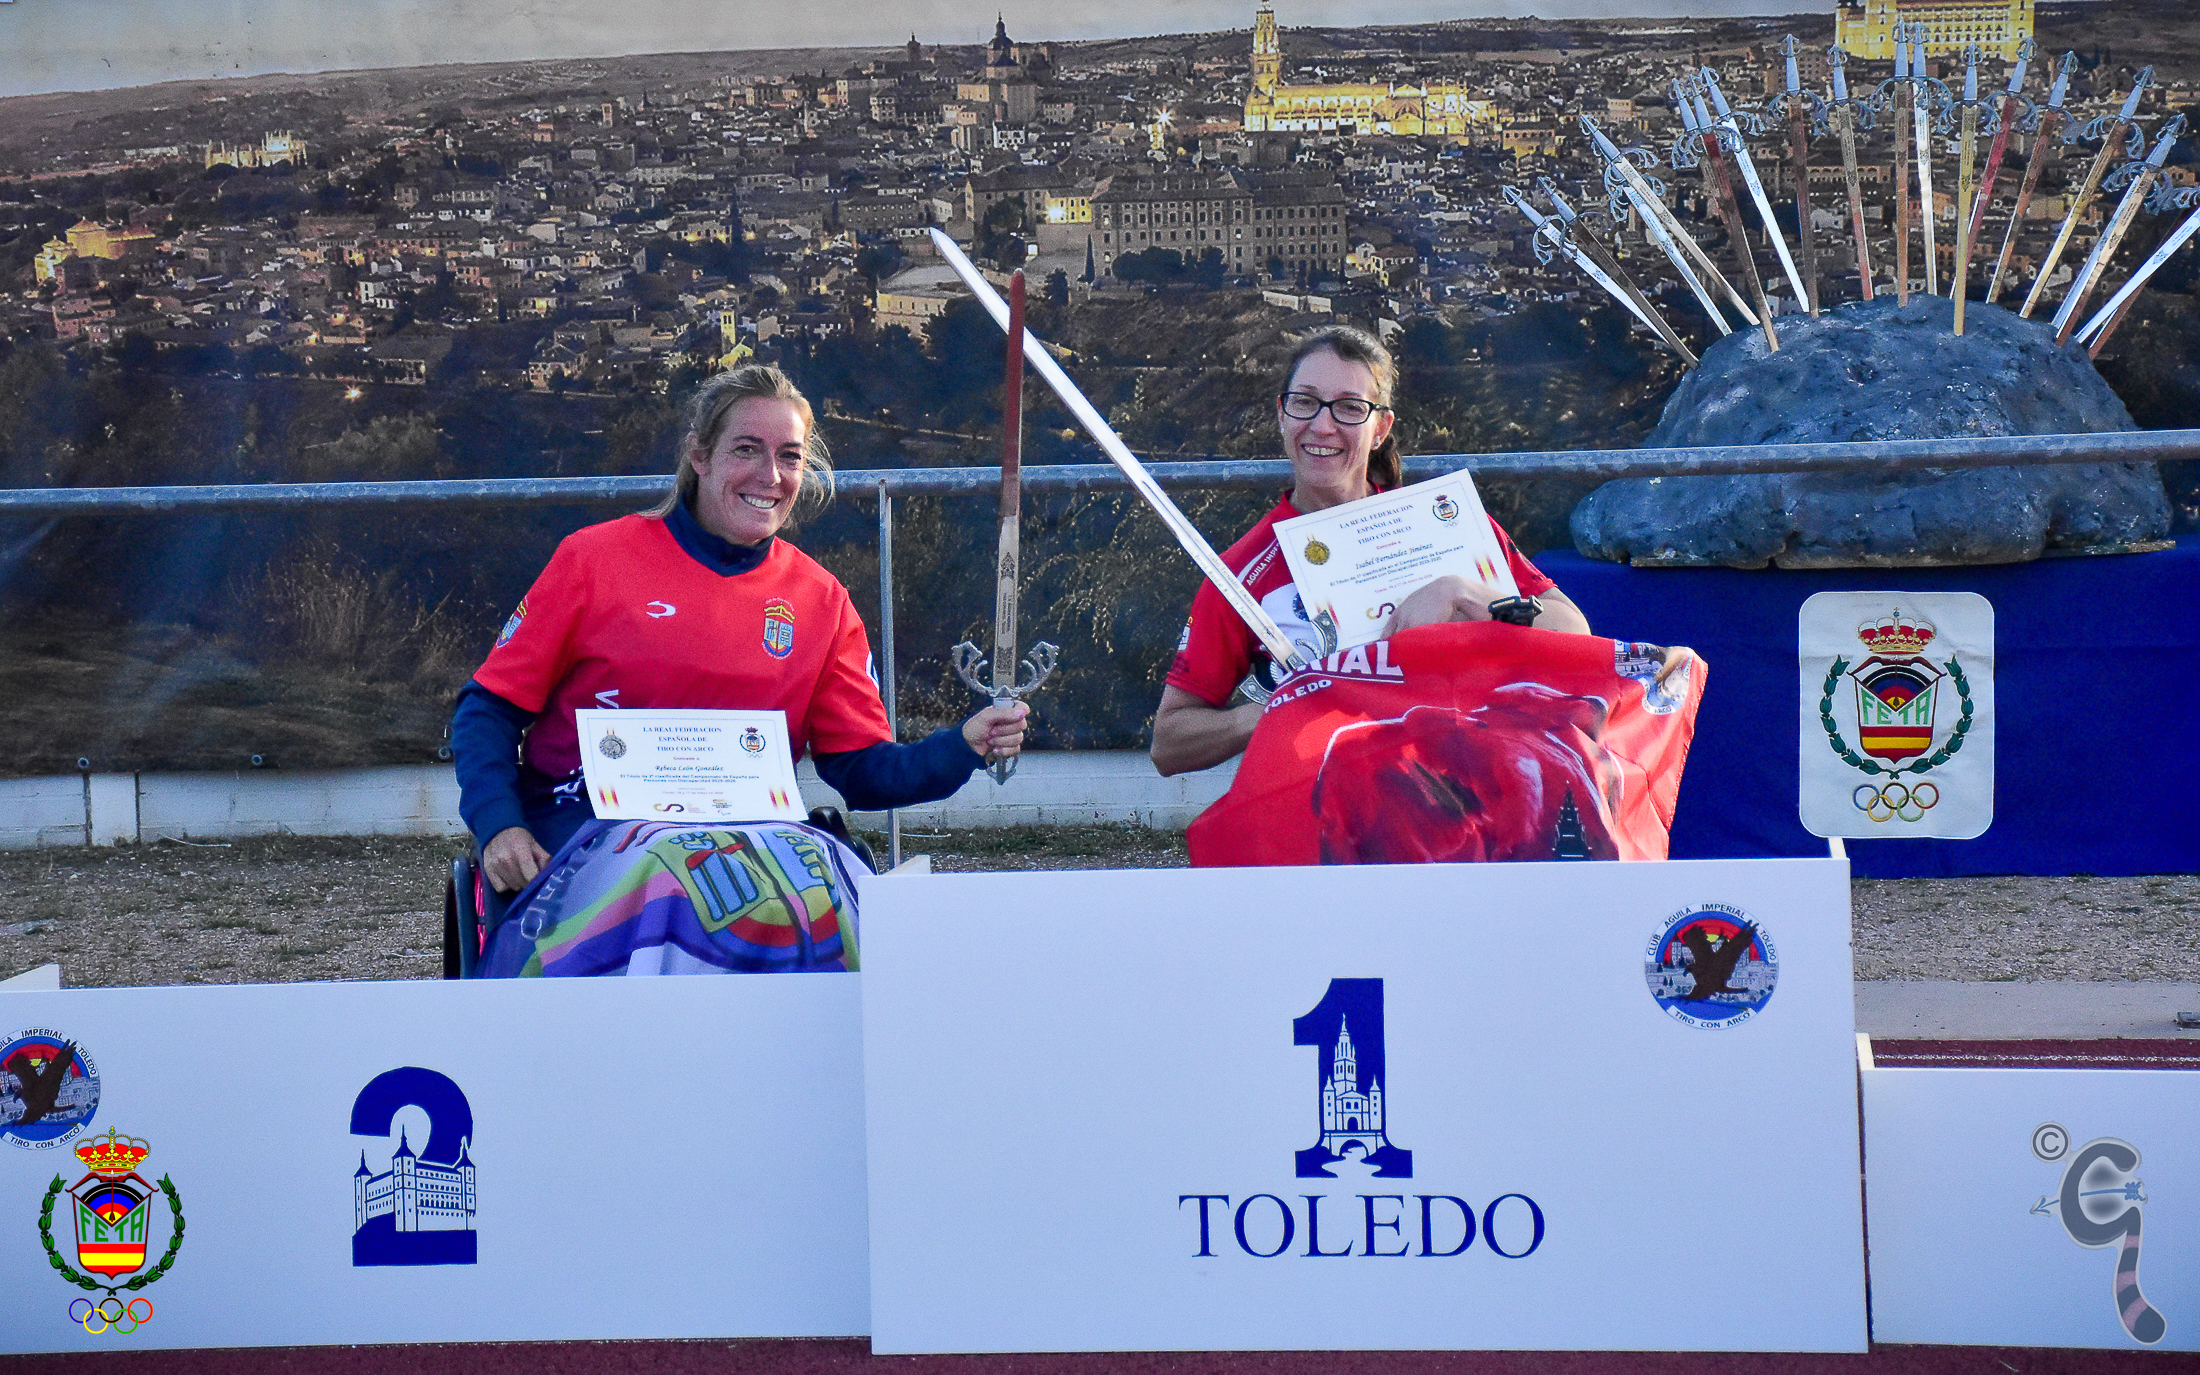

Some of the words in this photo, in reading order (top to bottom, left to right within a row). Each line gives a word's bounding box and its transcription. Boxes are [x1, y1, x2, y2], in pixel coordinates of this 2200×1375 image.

[1350, 516, 1368, 526] REAL
[1358, 535, 1375, 545] TIRO
[1375, 531, 1391, 540] CON
[1392, 525, 1412, 535] ARCO
[1246, 562, 1267, 586] AGUILA
[1355, 559, 1375, 570] Isabel
[1860, 686, 1932, 726] FETA
[1647, 933, 1662, 956] CLUB
[1663, 907, 1692, 929] AGUILA
[1701, 902, 1746, 920] IMPERIAL
[1759, 930, 1777, 961] TOLEDO
[1674, 1010, 1696, 1025] TIRO
[1700, 1020, 1721, 1029] CON
[1726, 1011, 1751, 1027] ARCO
[20, 1028, 63, 1041] IMPERIAL
[77, 1045, 97, 1076] TOLEDO
[1293, 977, 1414, 1179] 1
[9, 1135, 31, 1149] TIRO
[35, 1140, 54, 1149] CON
[58, 1125, 81, 1145] ARCO
[79, 1202, 146, 1243] FETA
[1177, 1192, 1546, 1259] TOLEDO
